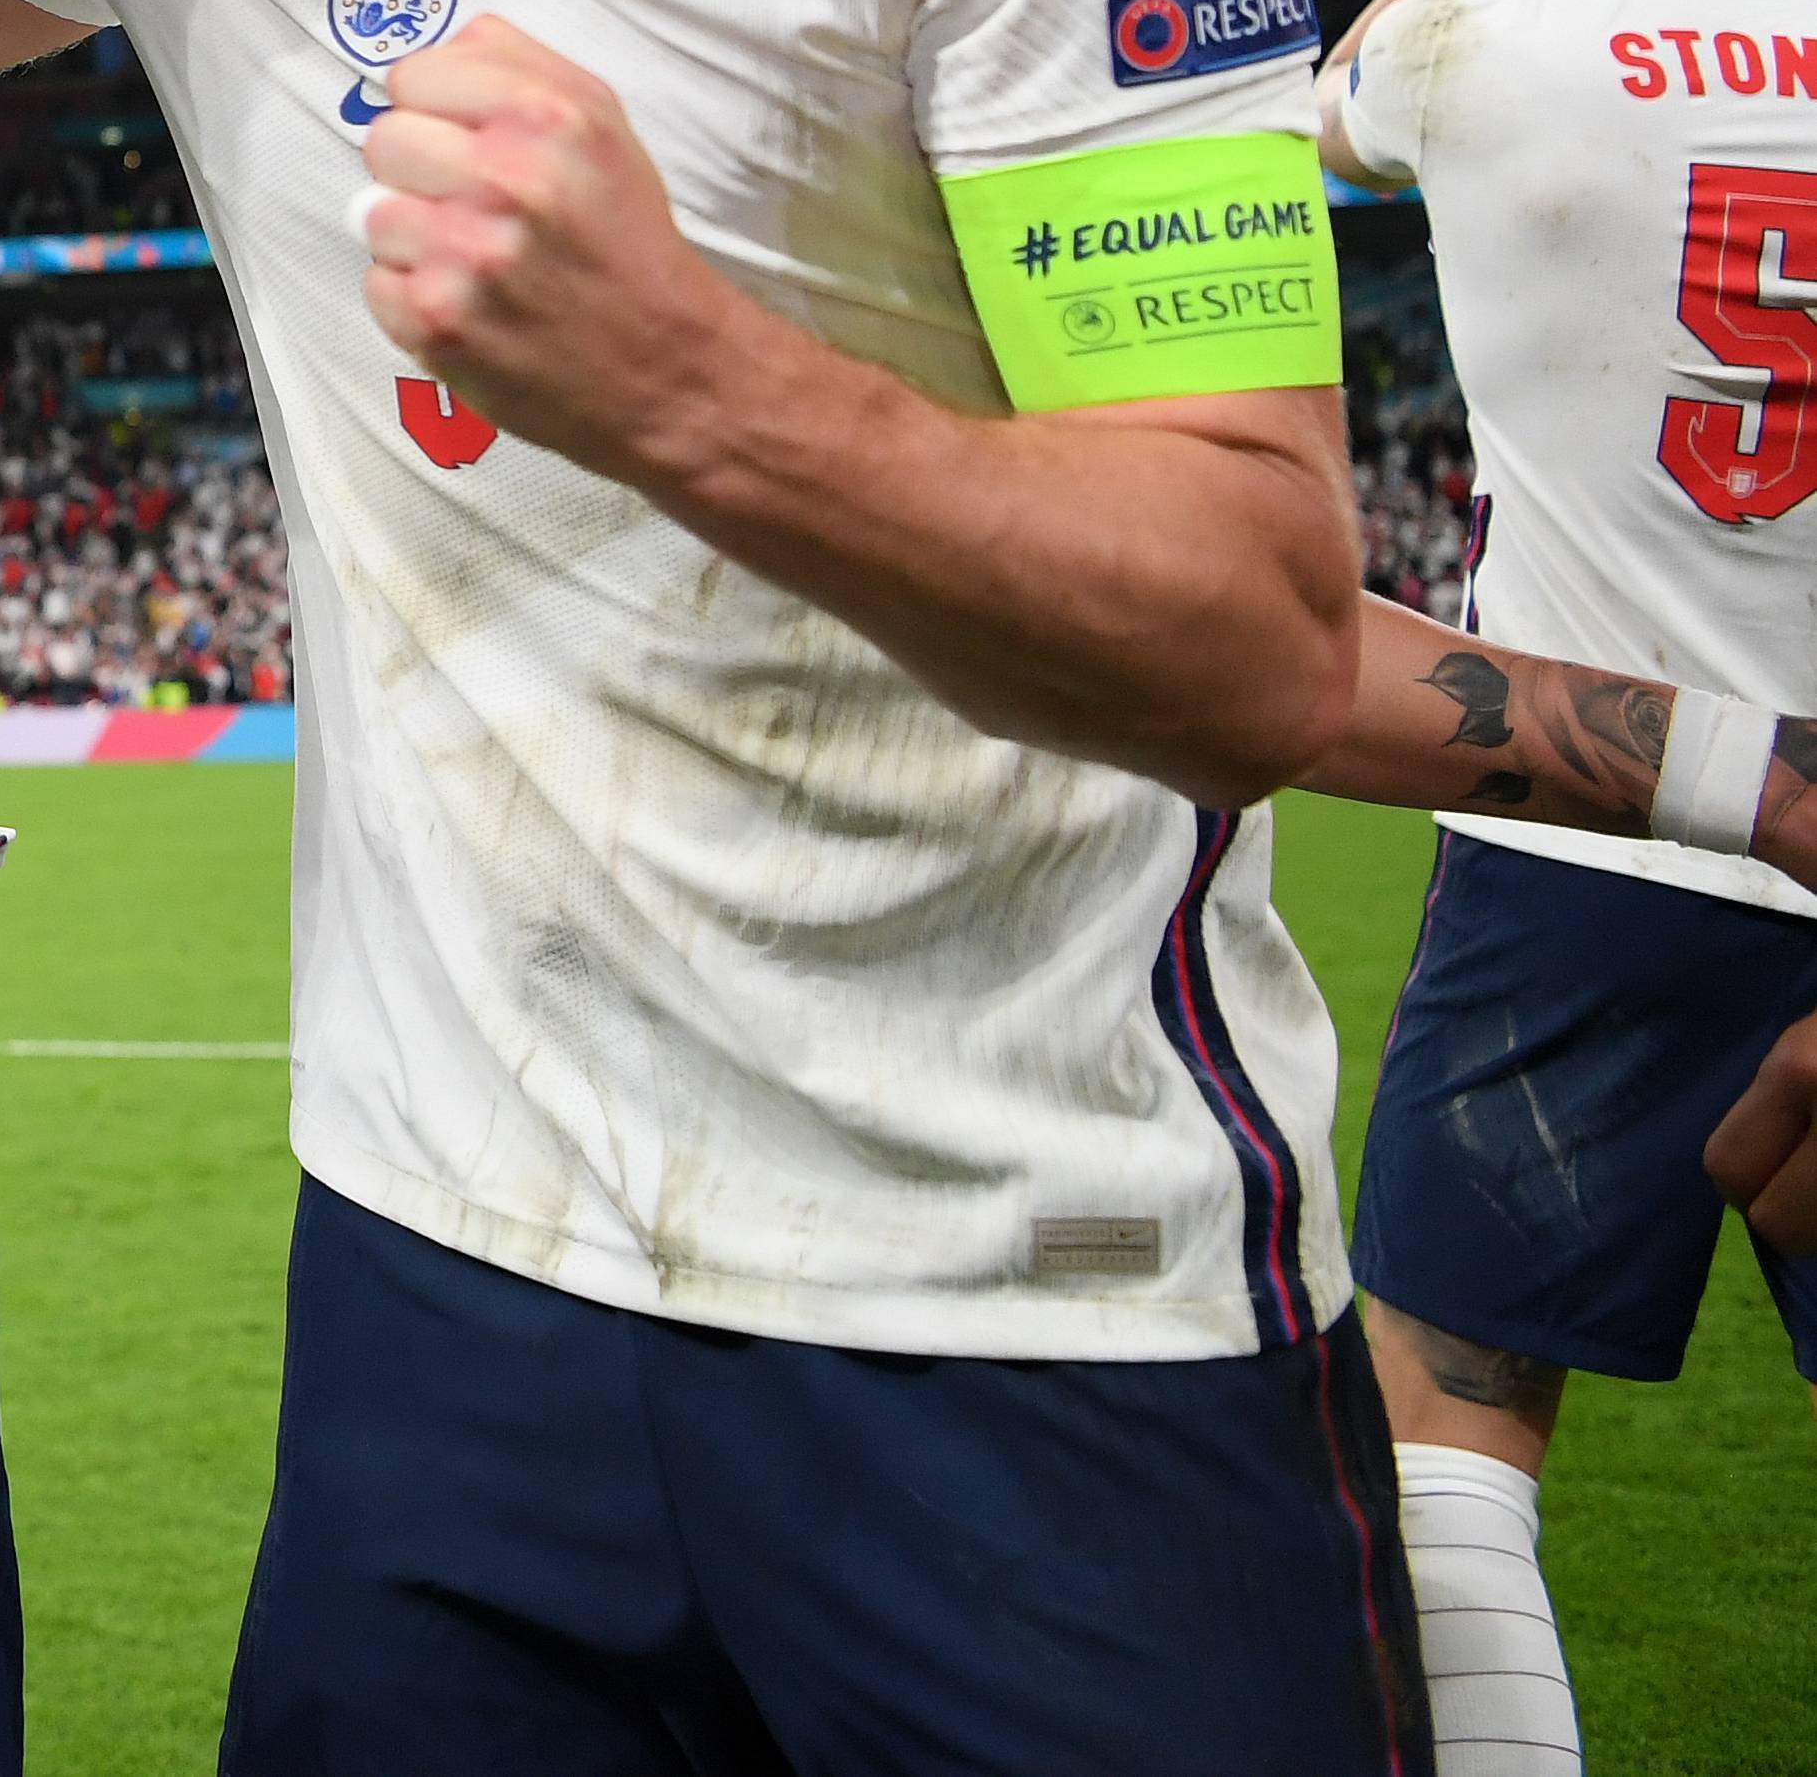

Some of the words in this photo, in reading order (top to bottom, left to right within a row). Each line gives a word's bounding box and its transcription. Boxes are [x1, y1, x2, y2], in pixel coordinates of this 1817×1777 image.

[1609, 29, 1817, 99] STON
[1135, 278, 1314, 329] RESPECT
[1657, 162, 1817, 524] 5
